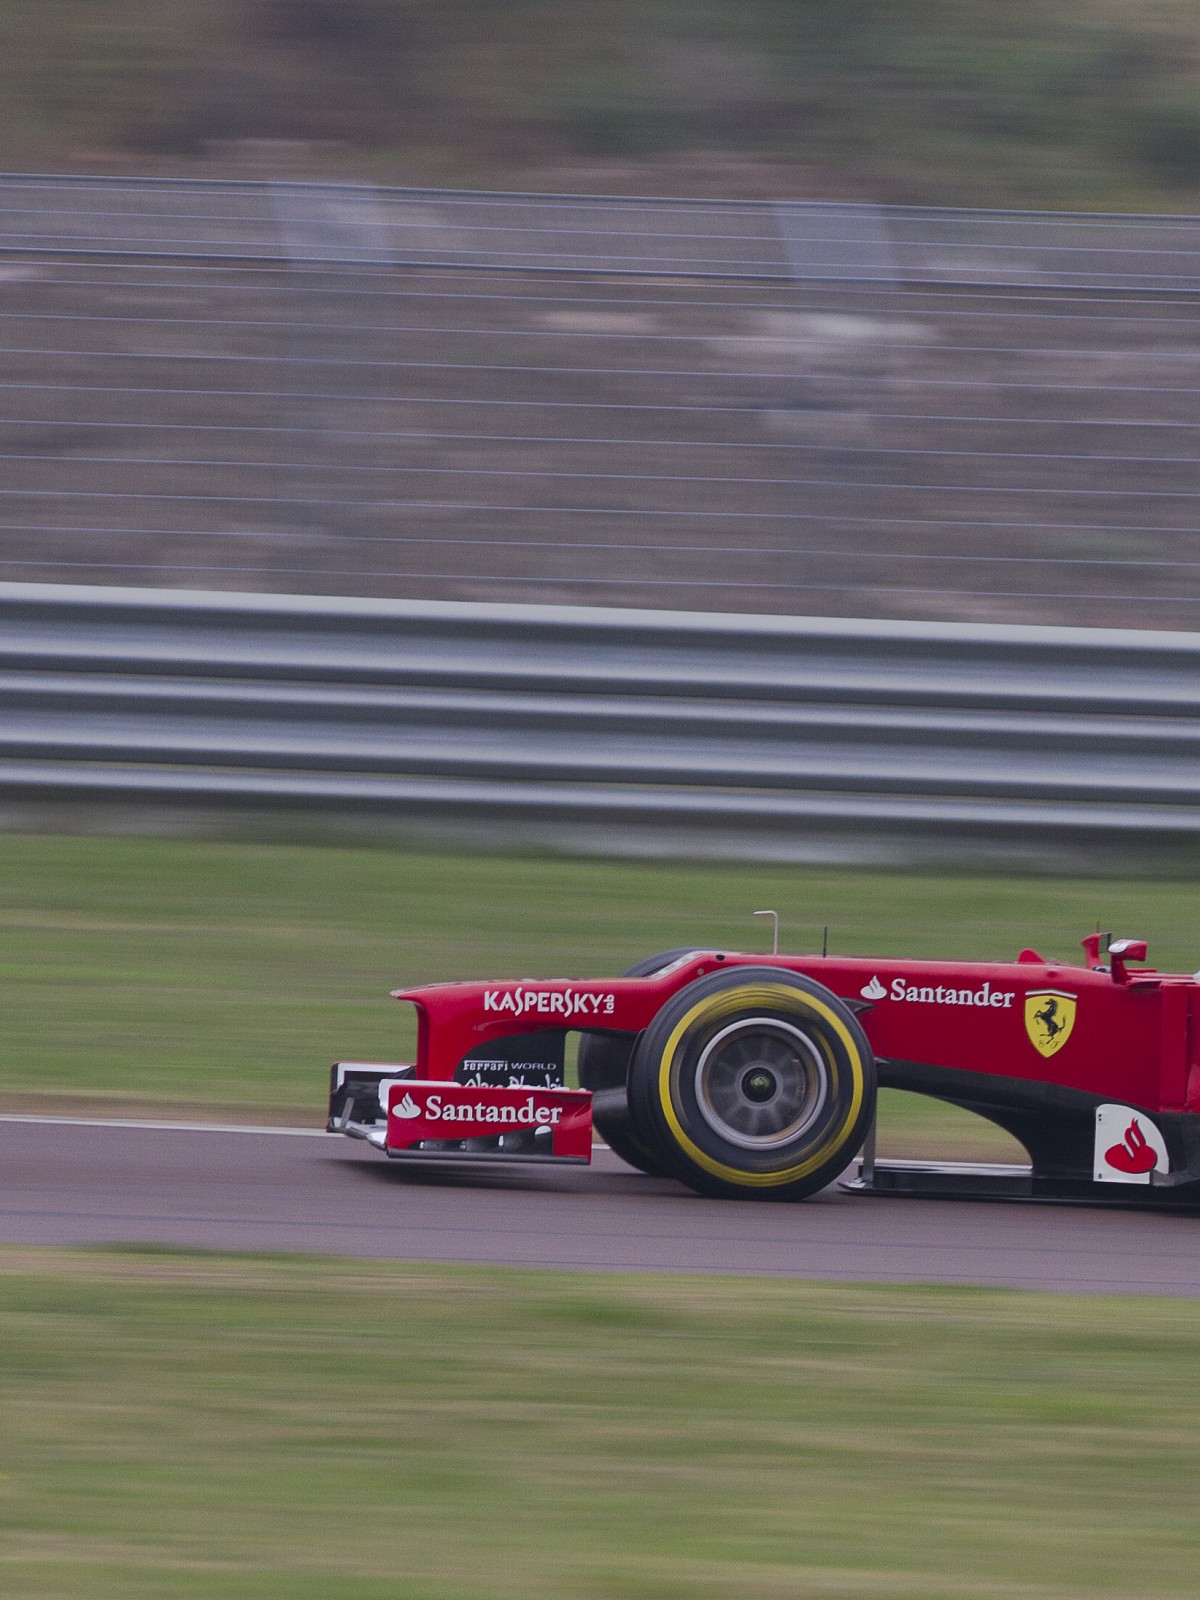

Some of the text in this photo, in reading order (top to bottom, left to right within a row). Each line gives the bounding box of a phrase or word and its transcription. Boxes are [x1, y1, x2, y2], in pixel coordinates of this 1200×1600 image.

[484, 987, 603, 1017] KASPERSKY
[890, 978, 1015, 1008] Santander
[511, 1062, 557, 1071] WORLD
[425, 1096, 562, 1124] Santander
